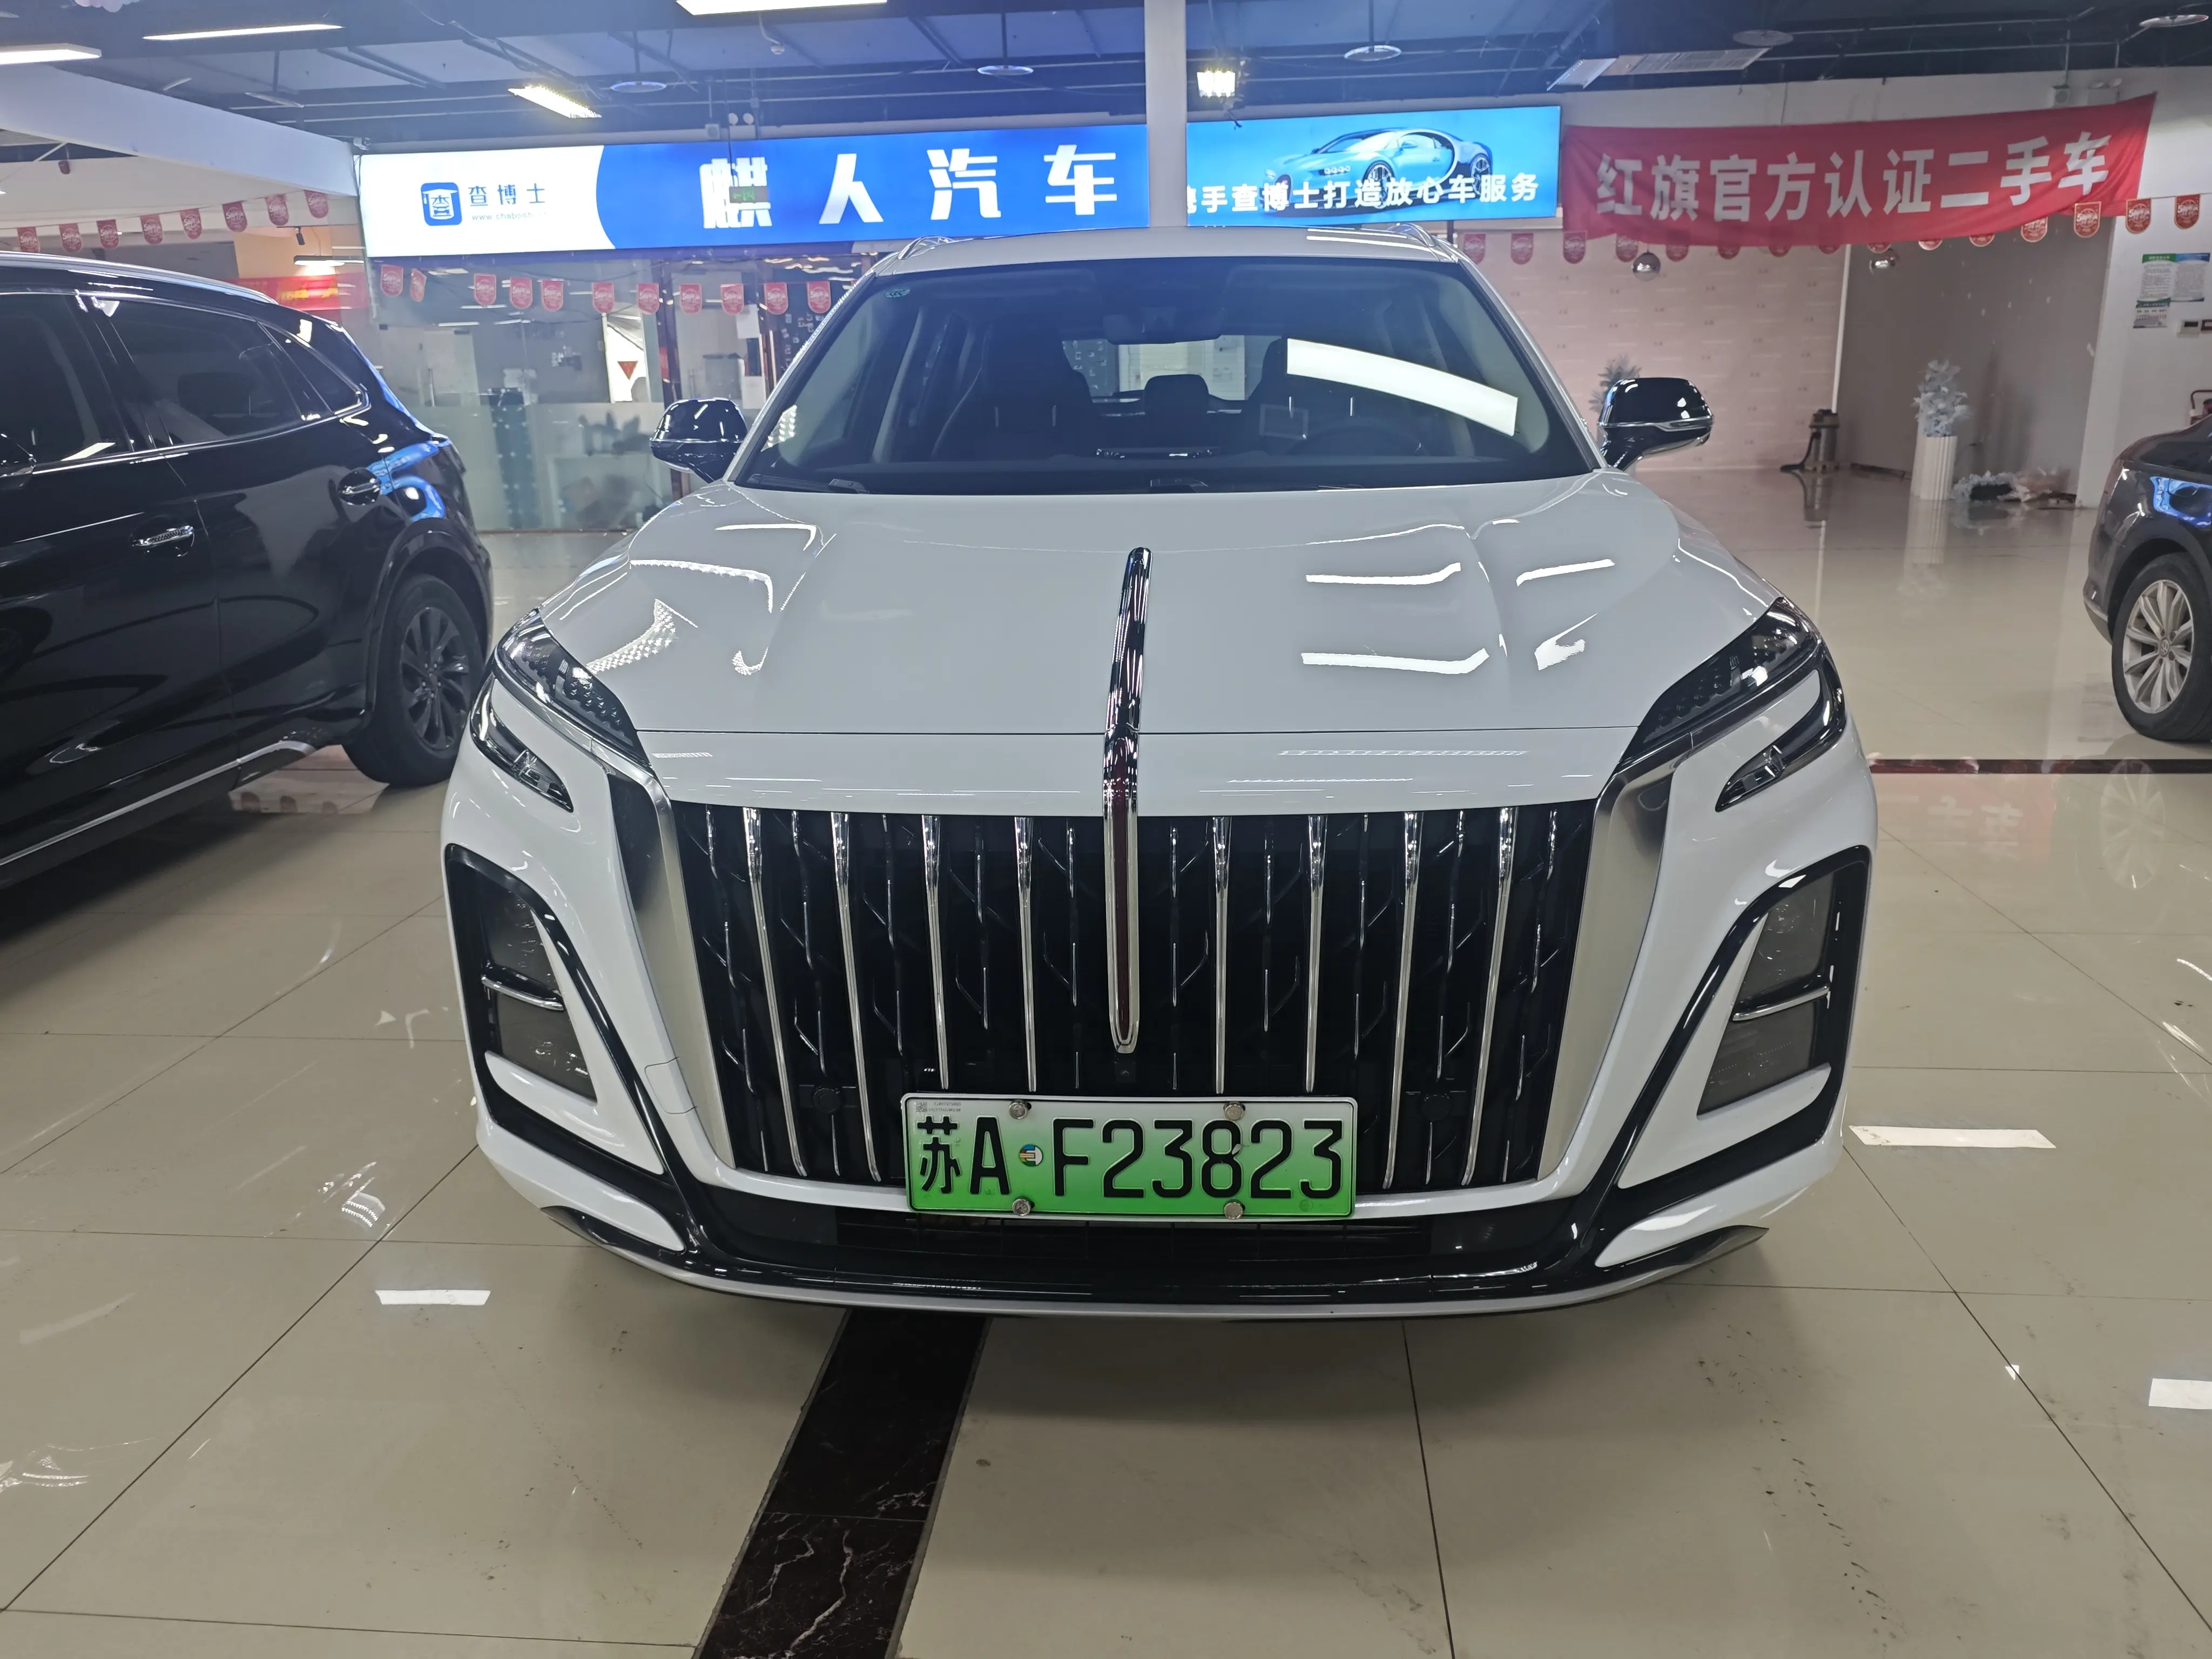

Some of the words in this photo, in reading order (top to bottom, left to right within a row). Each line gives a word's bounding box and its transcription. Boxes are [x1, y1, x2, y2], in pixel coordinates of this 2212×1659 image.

[468, 183, 546, 207] 查博士
[1596, 132, 2111, 222] 红旗官方认证二手车
